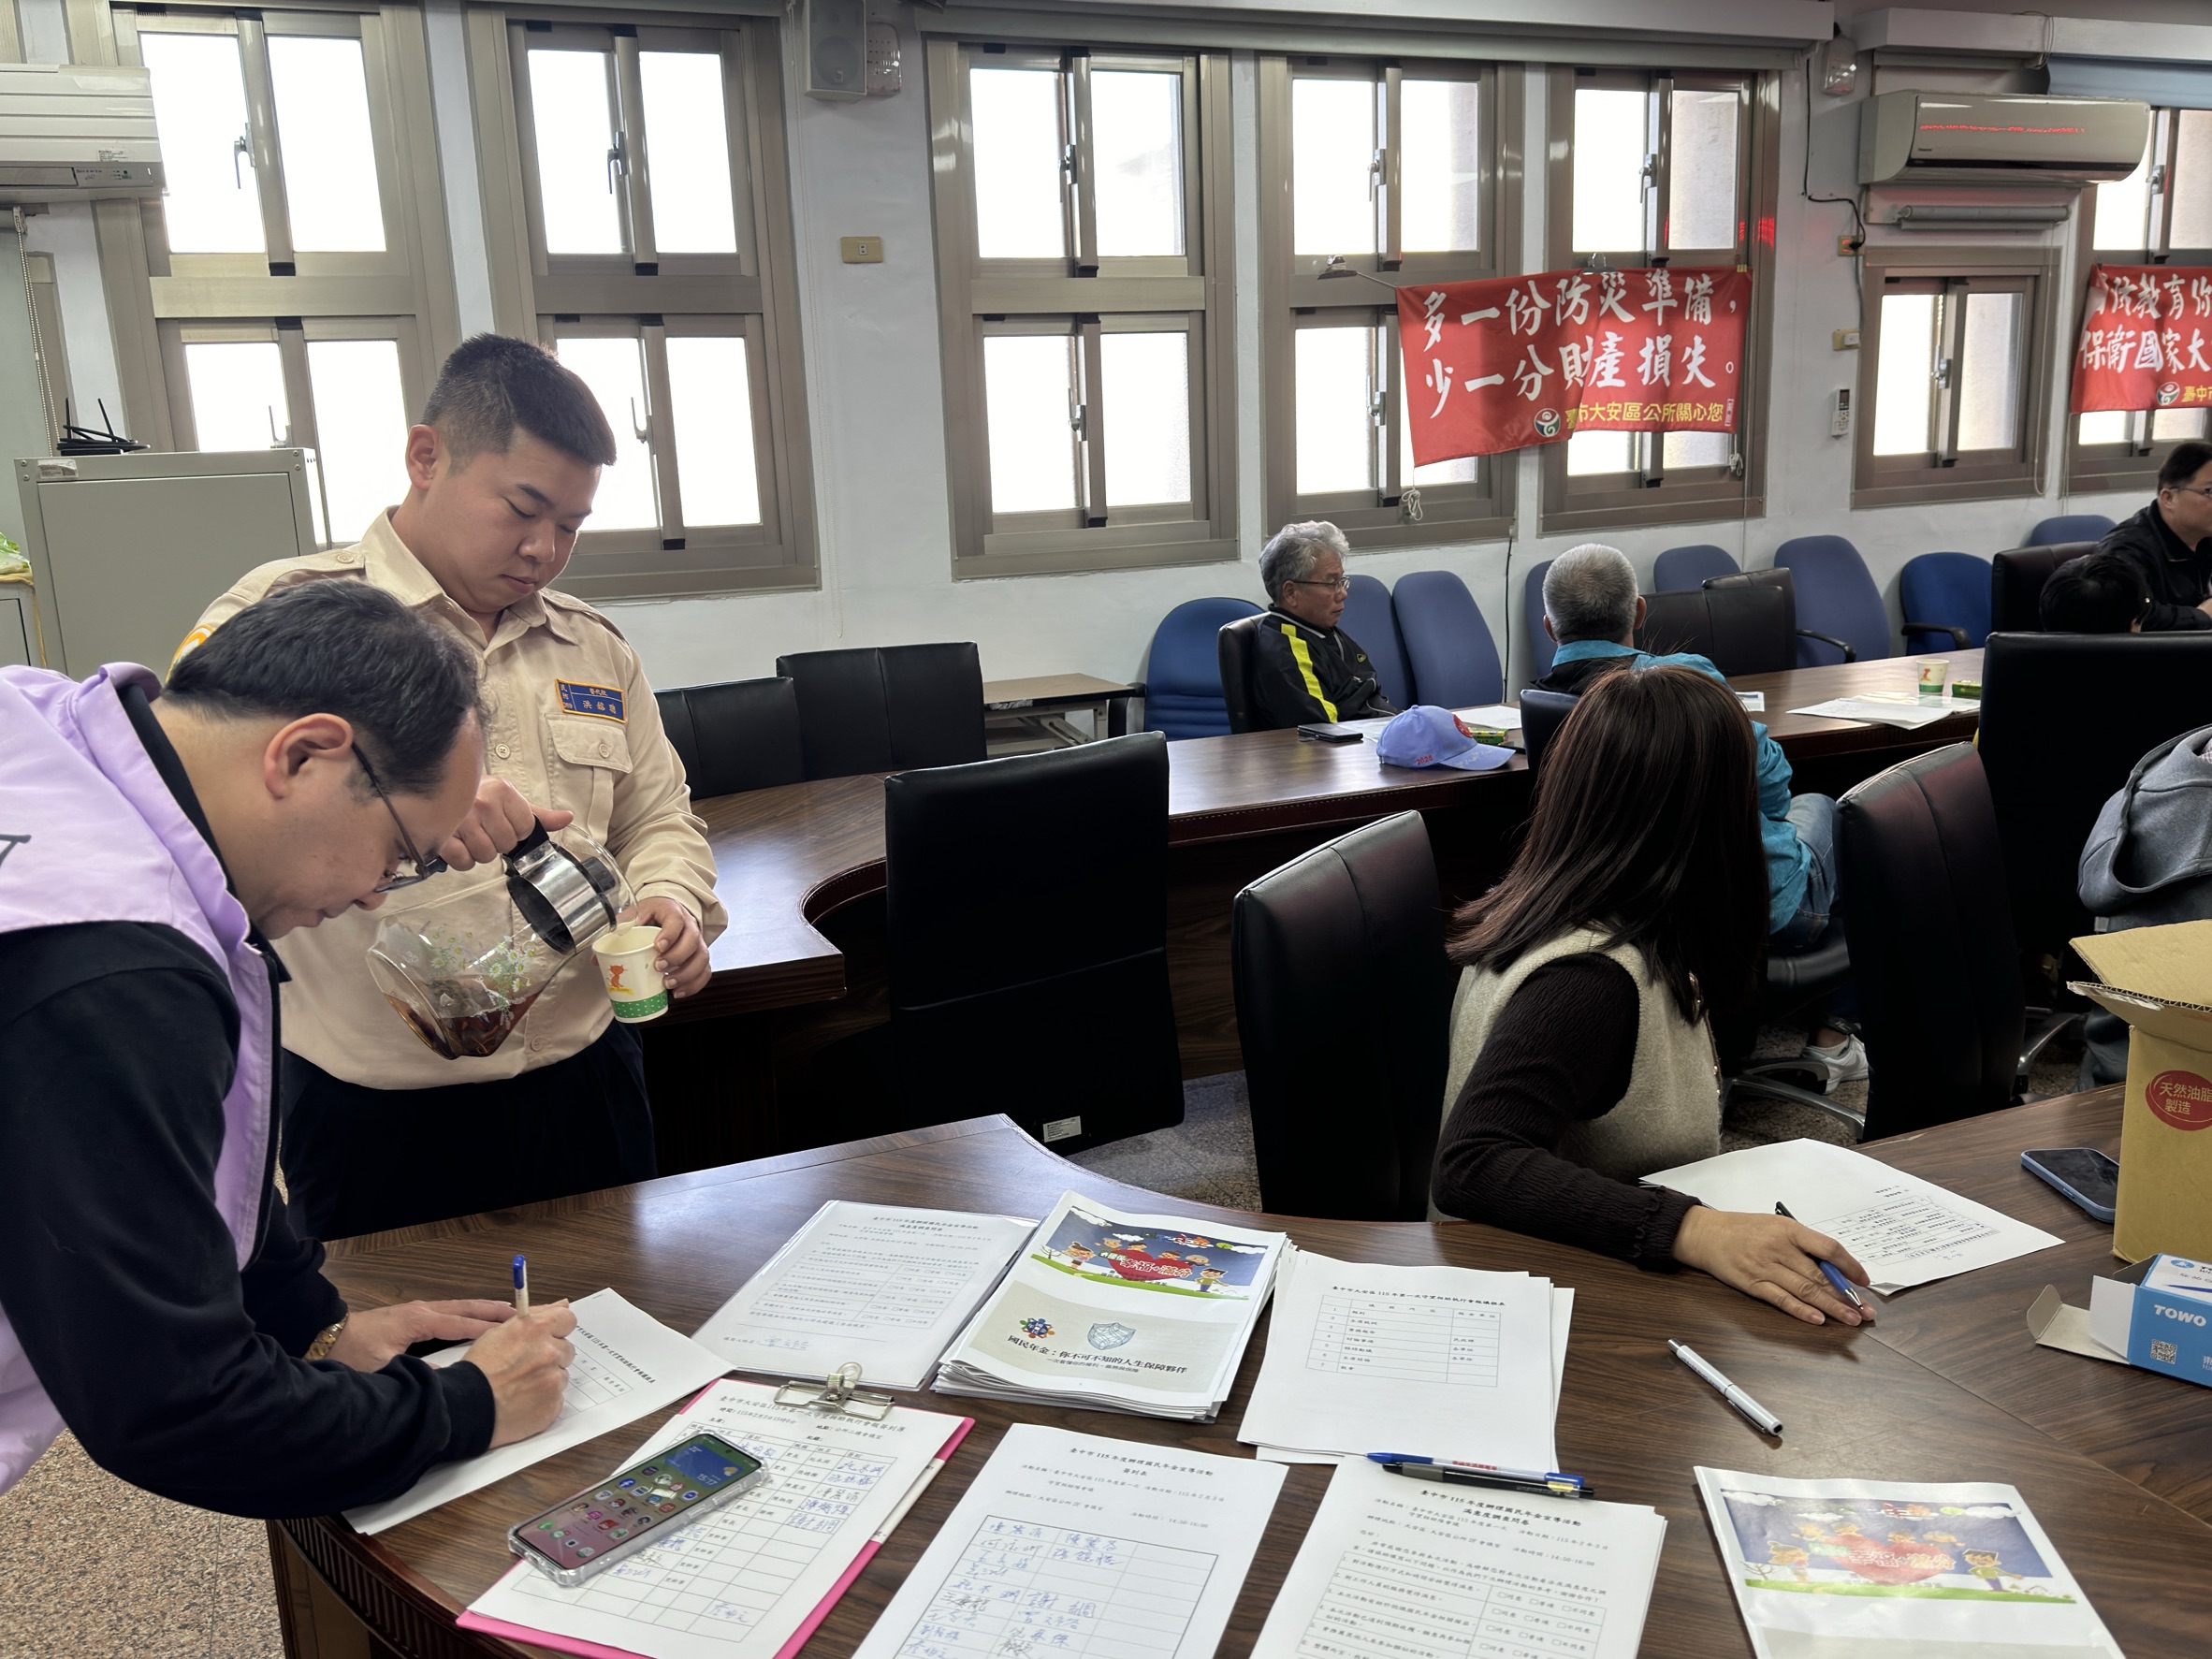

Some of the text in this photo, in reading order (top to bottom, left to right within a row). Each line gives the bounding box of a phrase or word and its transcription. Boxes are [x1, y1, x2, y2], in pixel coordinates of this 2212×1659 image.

[1423, 269, 1737, 353] 多一份防災準備，
[2099, 272, 2212, 320] 防教育你
[2080, 324, 2212, 373] 保衛國家大
[1423, 330, 1734, 419] 少一分財產損失。
[1564, 401, 1724, 429] 臺市大安區公所關心您
[2160, 1082, 2212, 1102] 天然油脂
[2164, 1099, 2190, 1114] 製造
[2154, 1303, 2206, 1327] TOWO
[1007, 1334, 1188, 1374] 國民年金：你不可不知的人生保障夥伴
